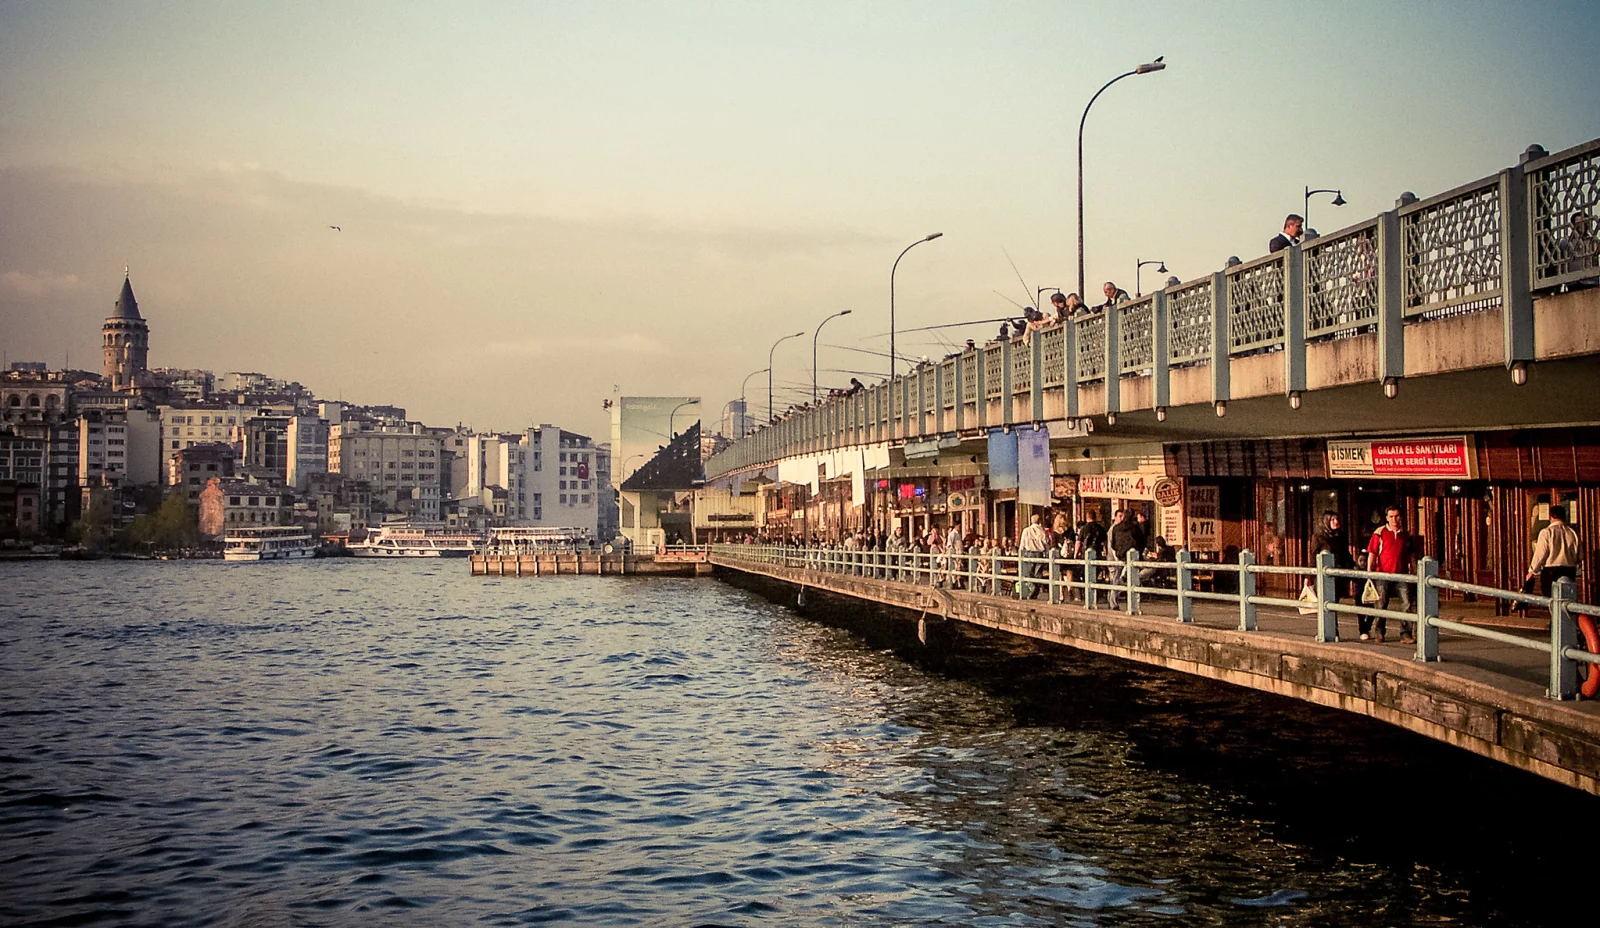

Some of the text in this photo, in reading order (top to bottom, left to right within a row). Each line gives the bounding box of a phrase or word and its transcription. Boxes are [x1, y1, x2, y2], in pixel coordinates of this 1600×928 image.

[1336, 445, 1364, 461] İSMEK
[1377, 444, 1457, 455] GALATA EL SANATLARI
[1374, 457, 1394, 466] SATIŞ
[1394, 457, 1404, 466] VE
[1405, 456, 1427, 466] SERGİ
[1428, 456, 1462, 466] MERKEZİ
[1135, 477, 1145, 495] 4
[1190, 521, 1197, 535] 4
[1200, 521, 1215, 535] YTL
